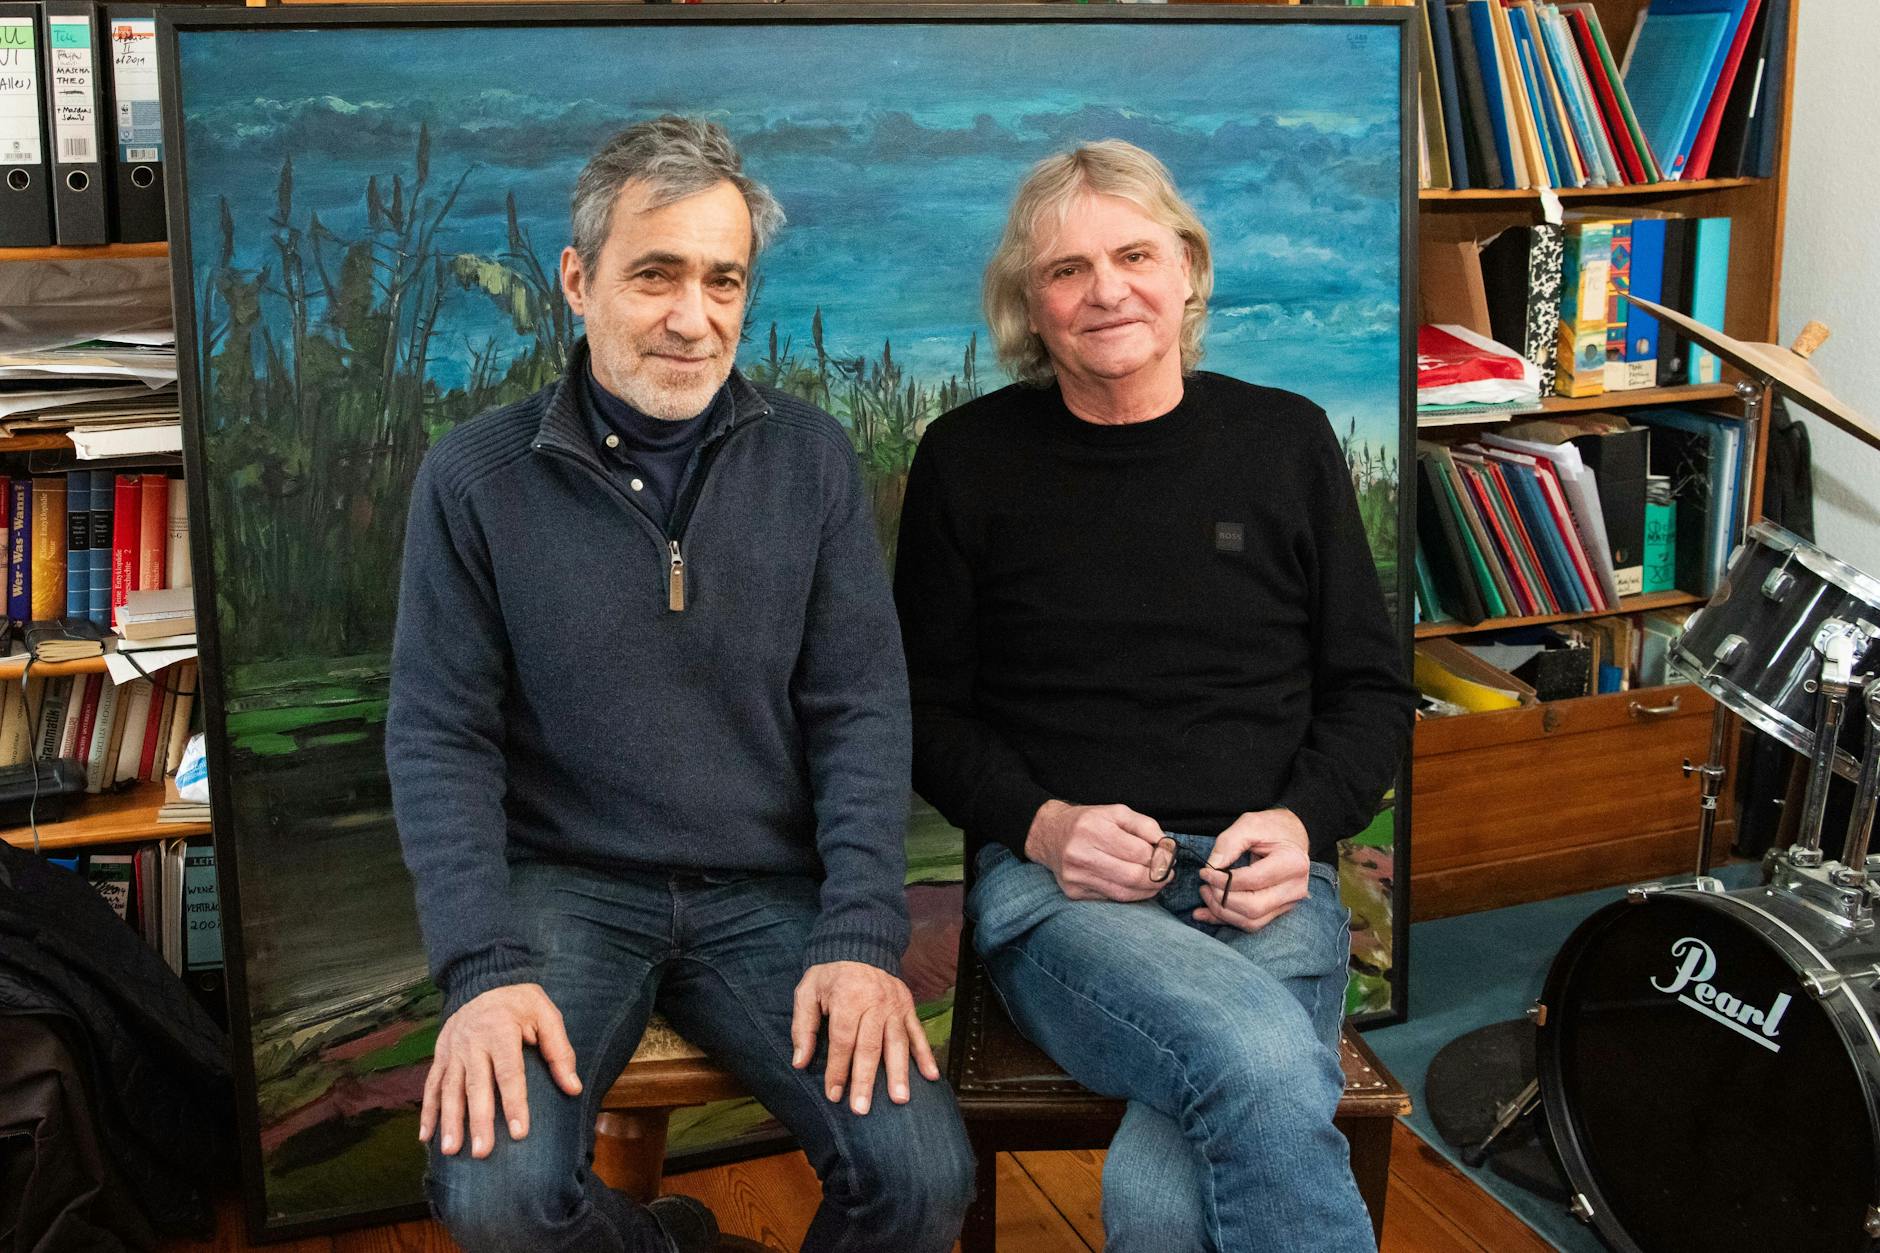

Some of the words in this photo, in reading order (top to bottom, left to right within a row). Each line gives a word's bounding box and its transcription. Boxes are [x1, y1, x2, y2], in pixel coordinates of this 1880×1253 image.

[13, 538, 24, 564] Was
[12, 572, 24, 598] Wer
[115, 549, 124, 589] Enzyklopädie
[1650, 937, 1792, 1037] Pearl
